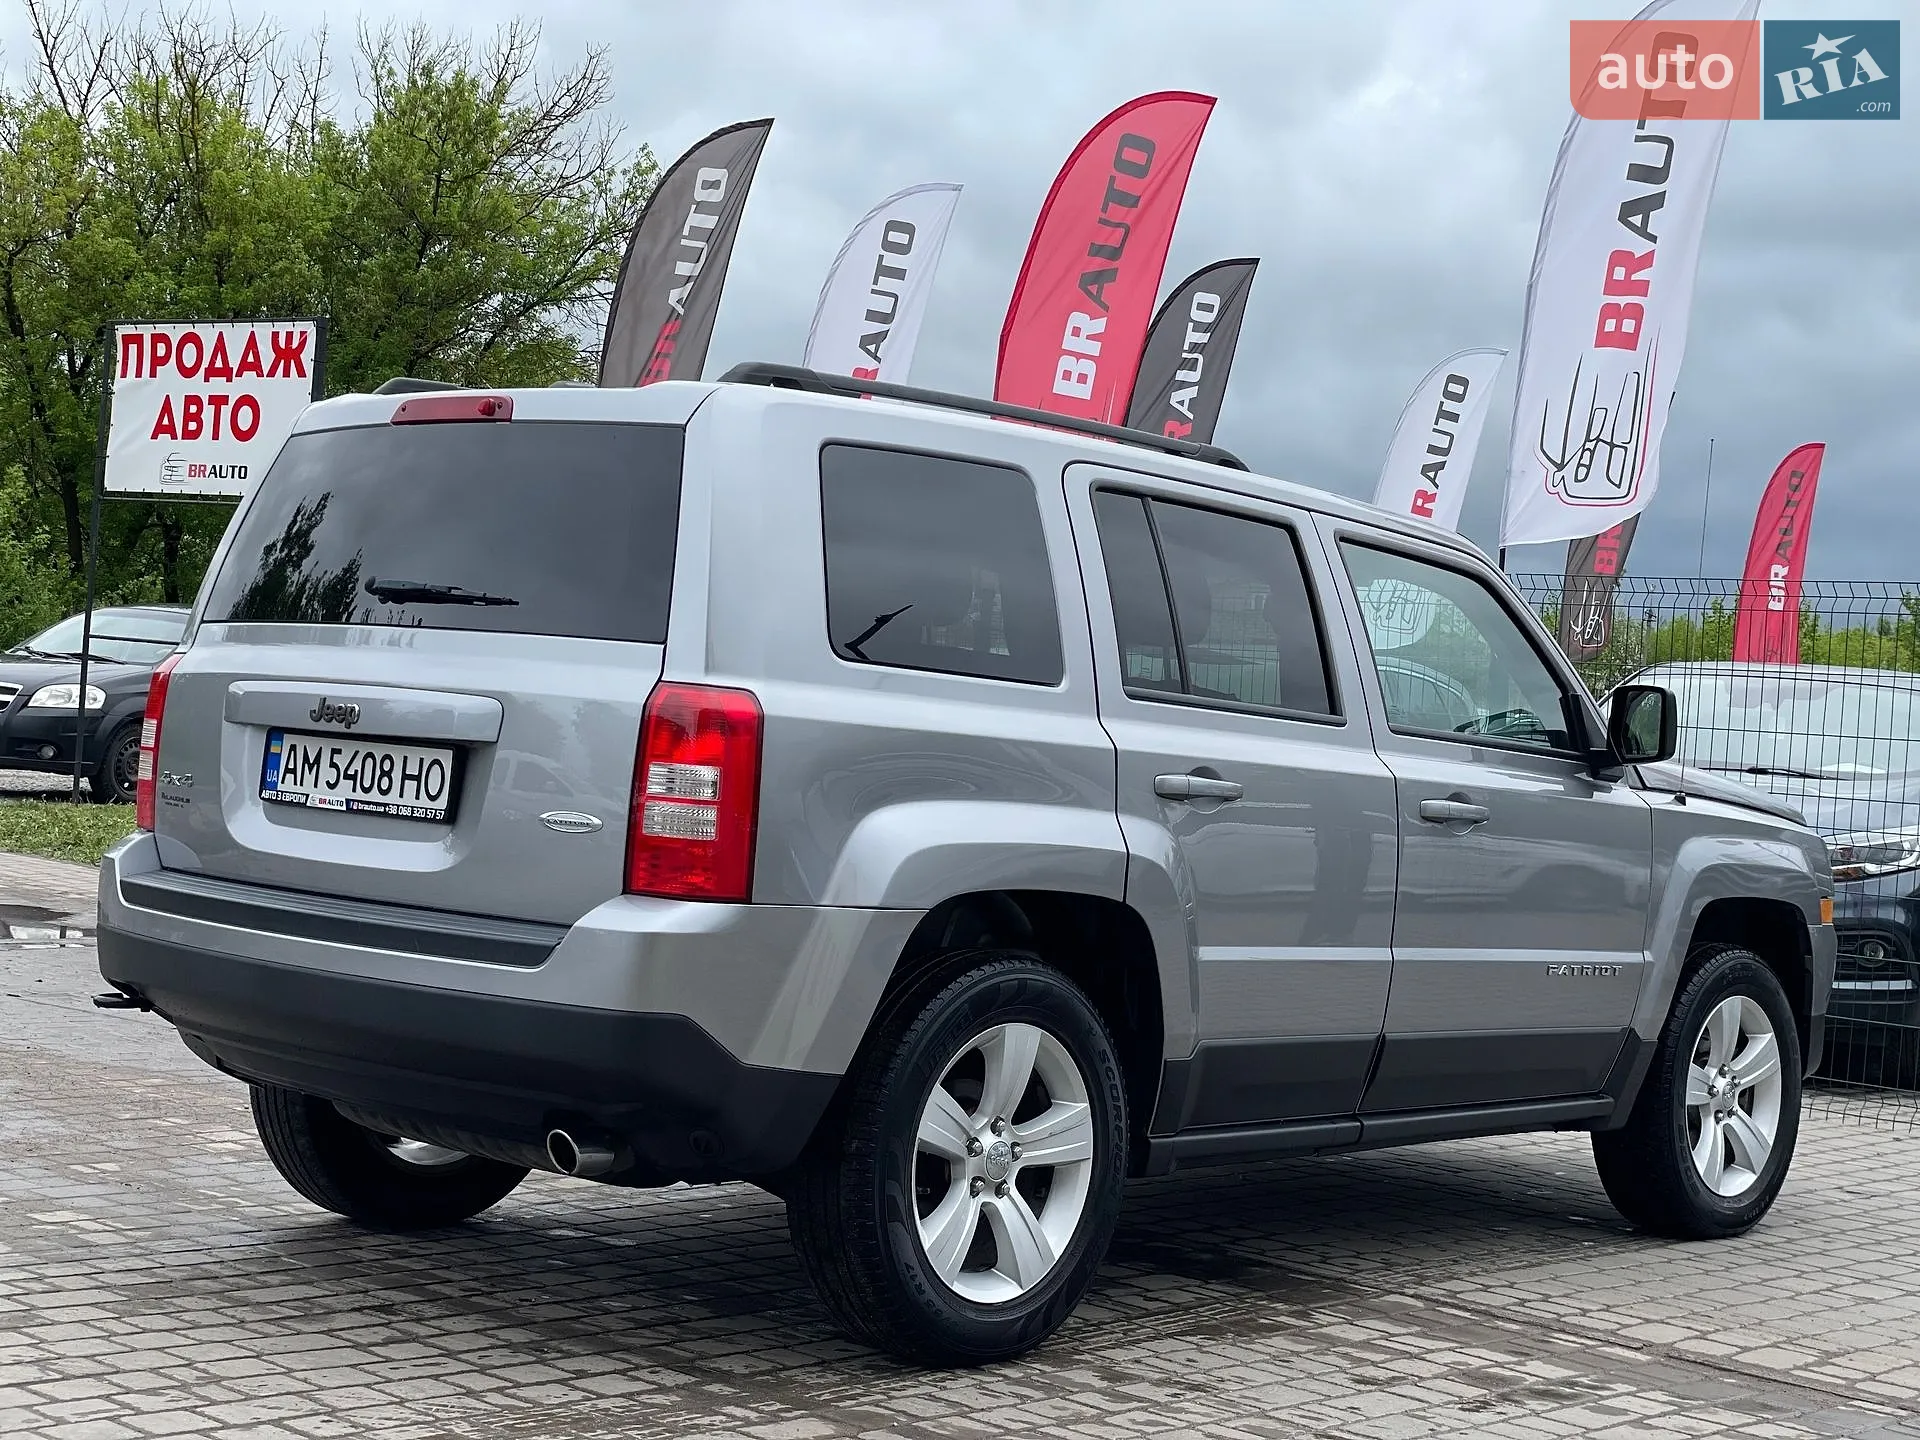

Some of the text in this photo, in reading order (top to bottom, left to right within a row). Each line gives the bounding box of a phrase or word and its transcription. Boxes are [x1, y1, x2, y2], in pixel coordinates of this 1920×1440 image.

[1594, 31, 1699, 351] BRAUTO
[1053, 132, 1156, 401] BRAUTO
[120, 330, 308, 383] ПРОДАЖ
[150, 393, 261, 442] АВТО
[188, 464, 248, 480] BRAUTO
[1768, 470, 1805, 611] BRAUTO
[310, 697, 360, 729] Jeep
[267, 769, 278, 783] UA
[281, 743, 323, 789] AM
[325, 747, 395, 796] 5408
[413, 807, 426, 818] 320
[1547, 964, 1622, 976] PATRIOT
